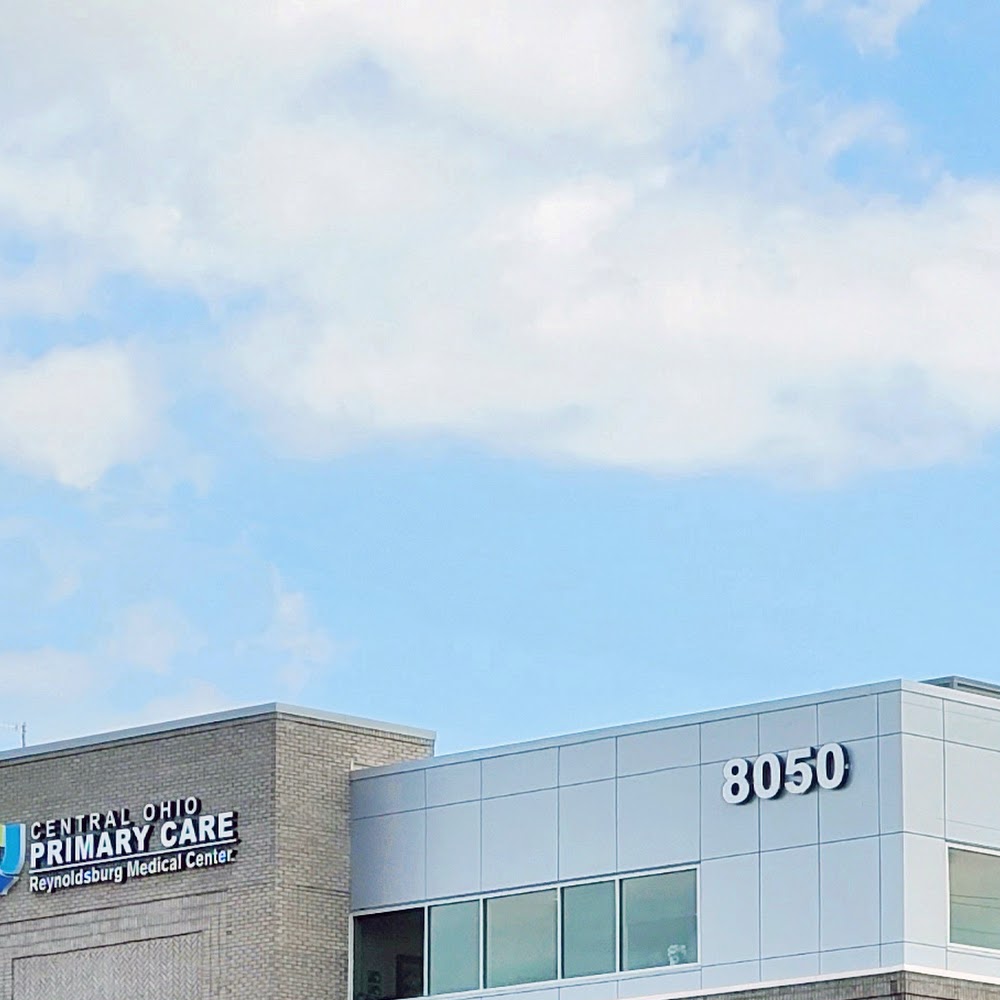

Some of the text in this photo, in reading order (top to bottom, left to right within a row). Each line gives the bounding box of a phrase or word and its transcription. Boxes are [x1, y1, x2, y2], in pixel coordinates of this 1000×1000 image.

[722, 742, 846, 804] 8050
[30, 811, 234, 868] PRIMARY CARE
[31, 796, 198, 840] CENTRAL OHIO
[30, 848, 234, 893] Reynoldsburg Medical Center
